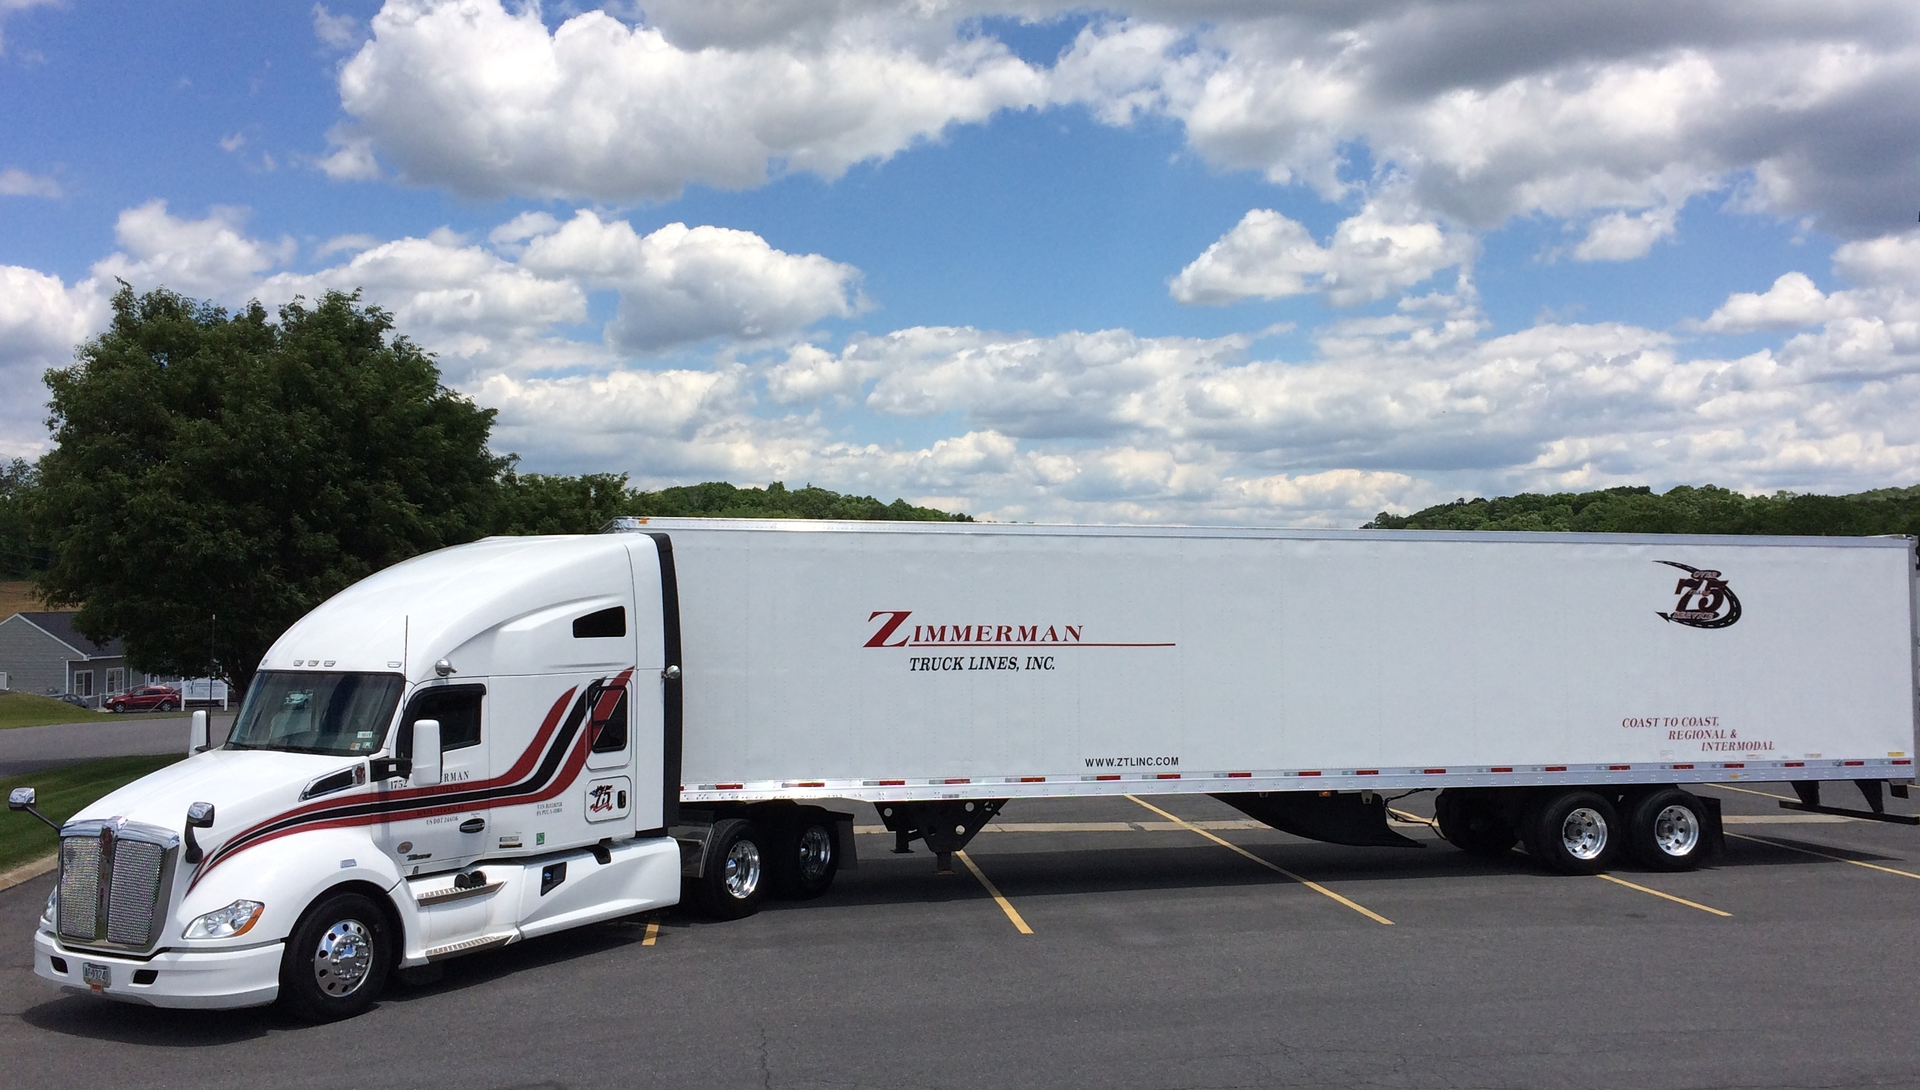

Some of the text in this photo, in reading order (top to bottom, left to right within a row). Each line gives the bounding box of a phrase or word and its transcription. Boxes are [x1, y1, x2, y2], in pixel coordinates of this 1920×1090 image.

[1674, 578, 1729, 612] 75
[863, 611, 1083, 648] ZIMMERMAN
[909, 656, 1056, 672] TRUCK LINES, INC.
[1622, 717, 1660, 728] COAST
[1663, 717, 1678, 727] TO
[1668, 729, 1737, 740] REGIONAL &
[1701, 740, 1775, 752] INTERMODAL
[1085, 757, 1179, 767] WWW.ZTLINC.COM
[390, 779, 408, 789] 1752
